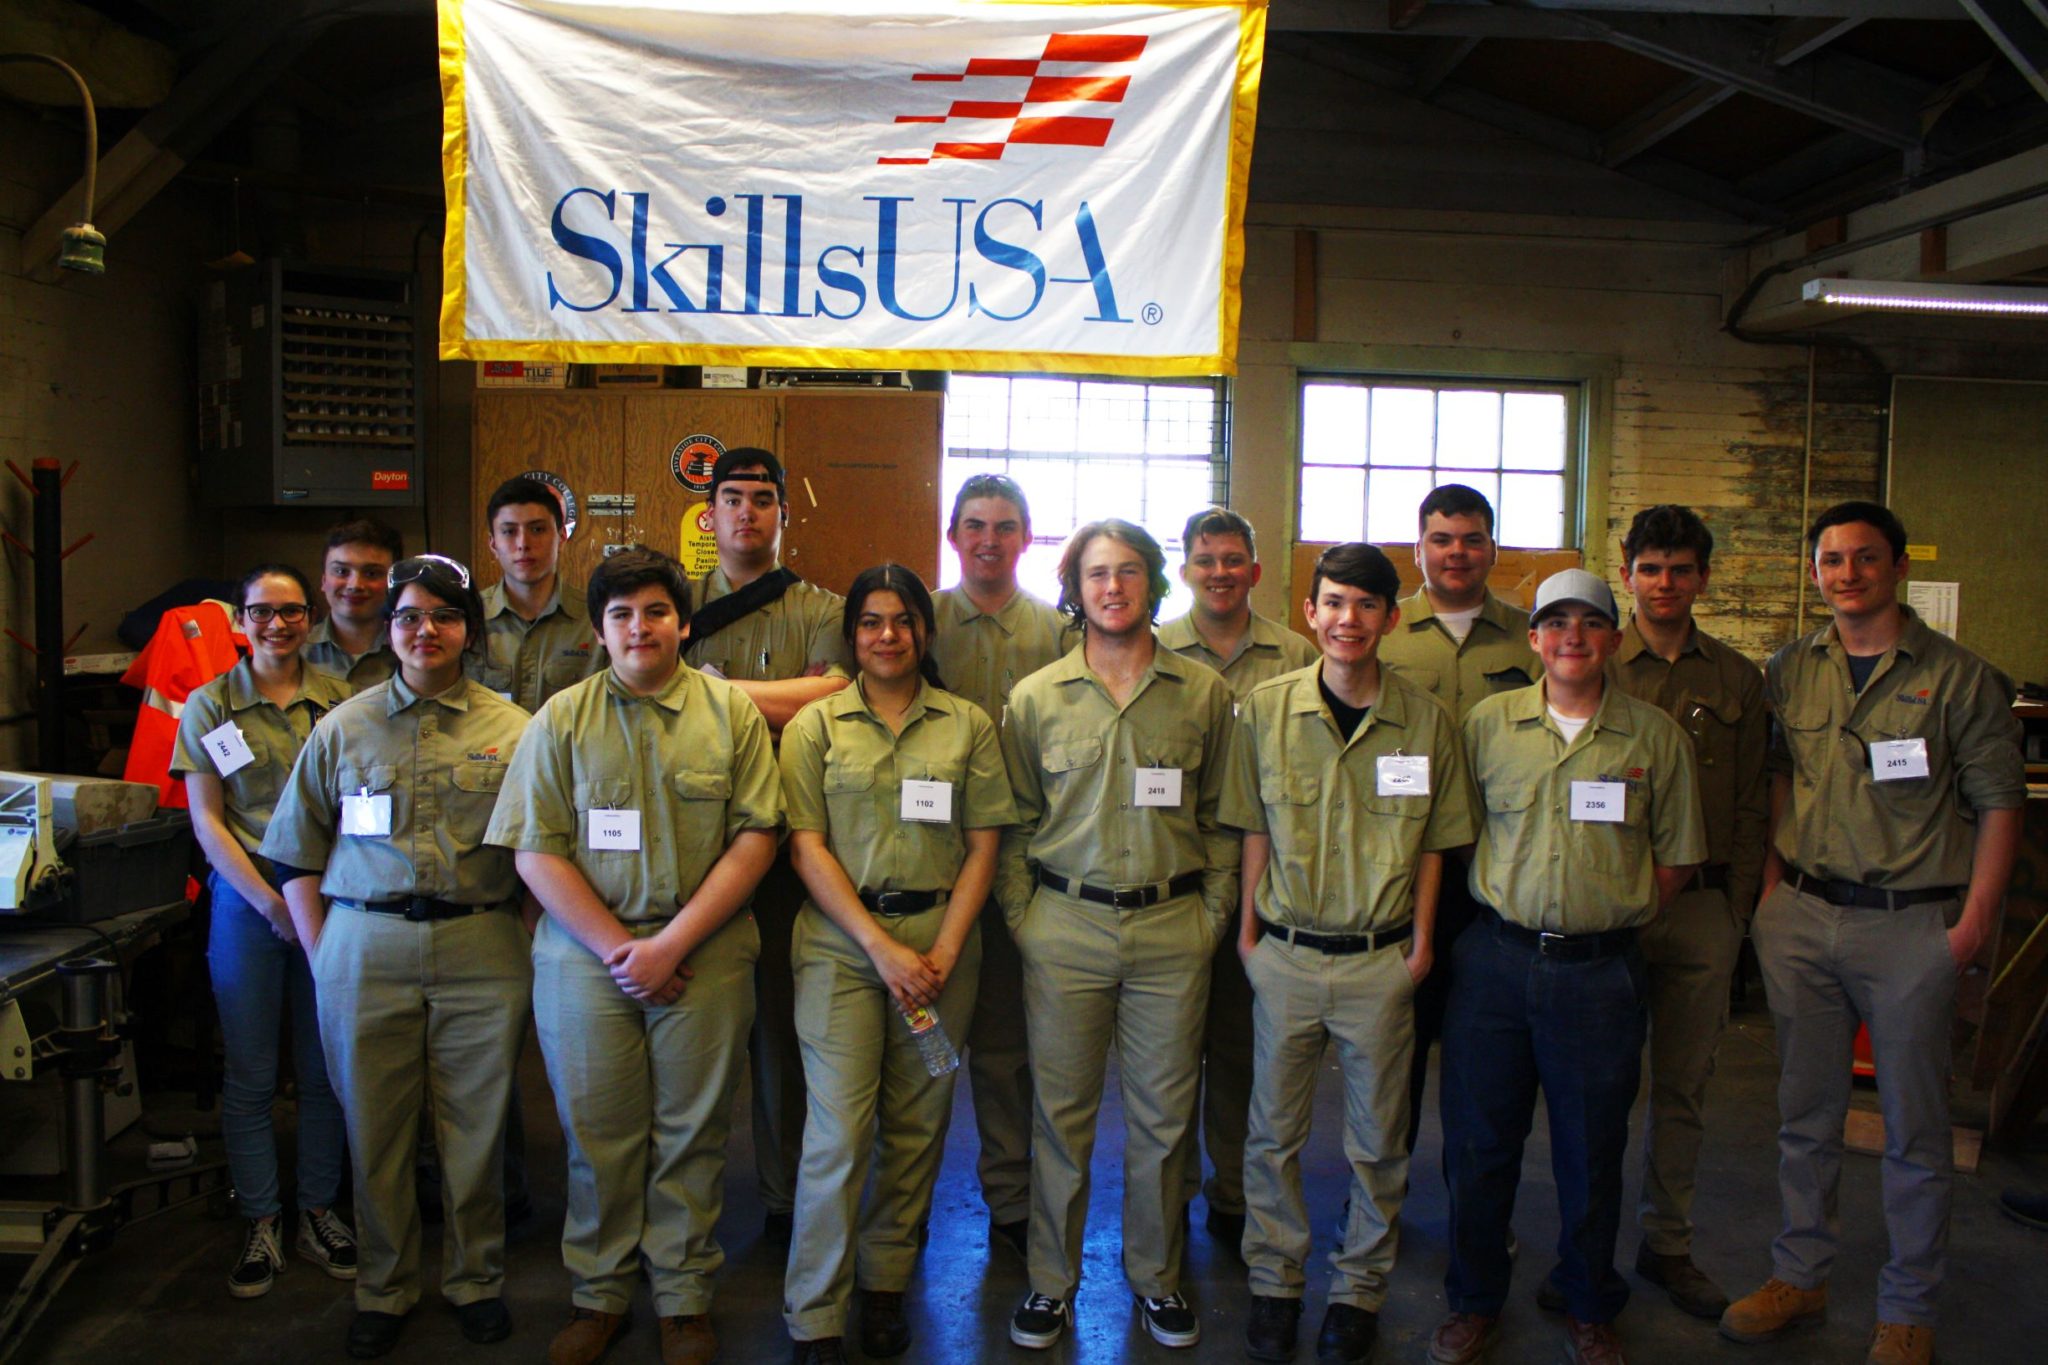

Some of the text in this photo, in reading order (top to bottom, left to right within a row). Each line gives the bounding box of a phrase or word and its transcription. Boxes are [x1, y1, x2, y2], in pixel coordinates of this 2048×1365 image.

[546, 187, 1134, 324] SkillsUSA
[524, 367, 553, 377] TILE
[673, 439, 694, 473] RIVERSIDE
[694, 437, 712, 445] CITY
[374, 472, 408, 484] Dayton
[524, 472, 551, 481] CITY
[217, 740, 232, 758] 2442
[1887, 758, 1908, 768] 2415
[1147, 787, 1166, 795] 2418
[916, 800, 935, 808] 1102
[1585, 801, 1607, 809] 2356
[603, 829, 622, 837] 1105
